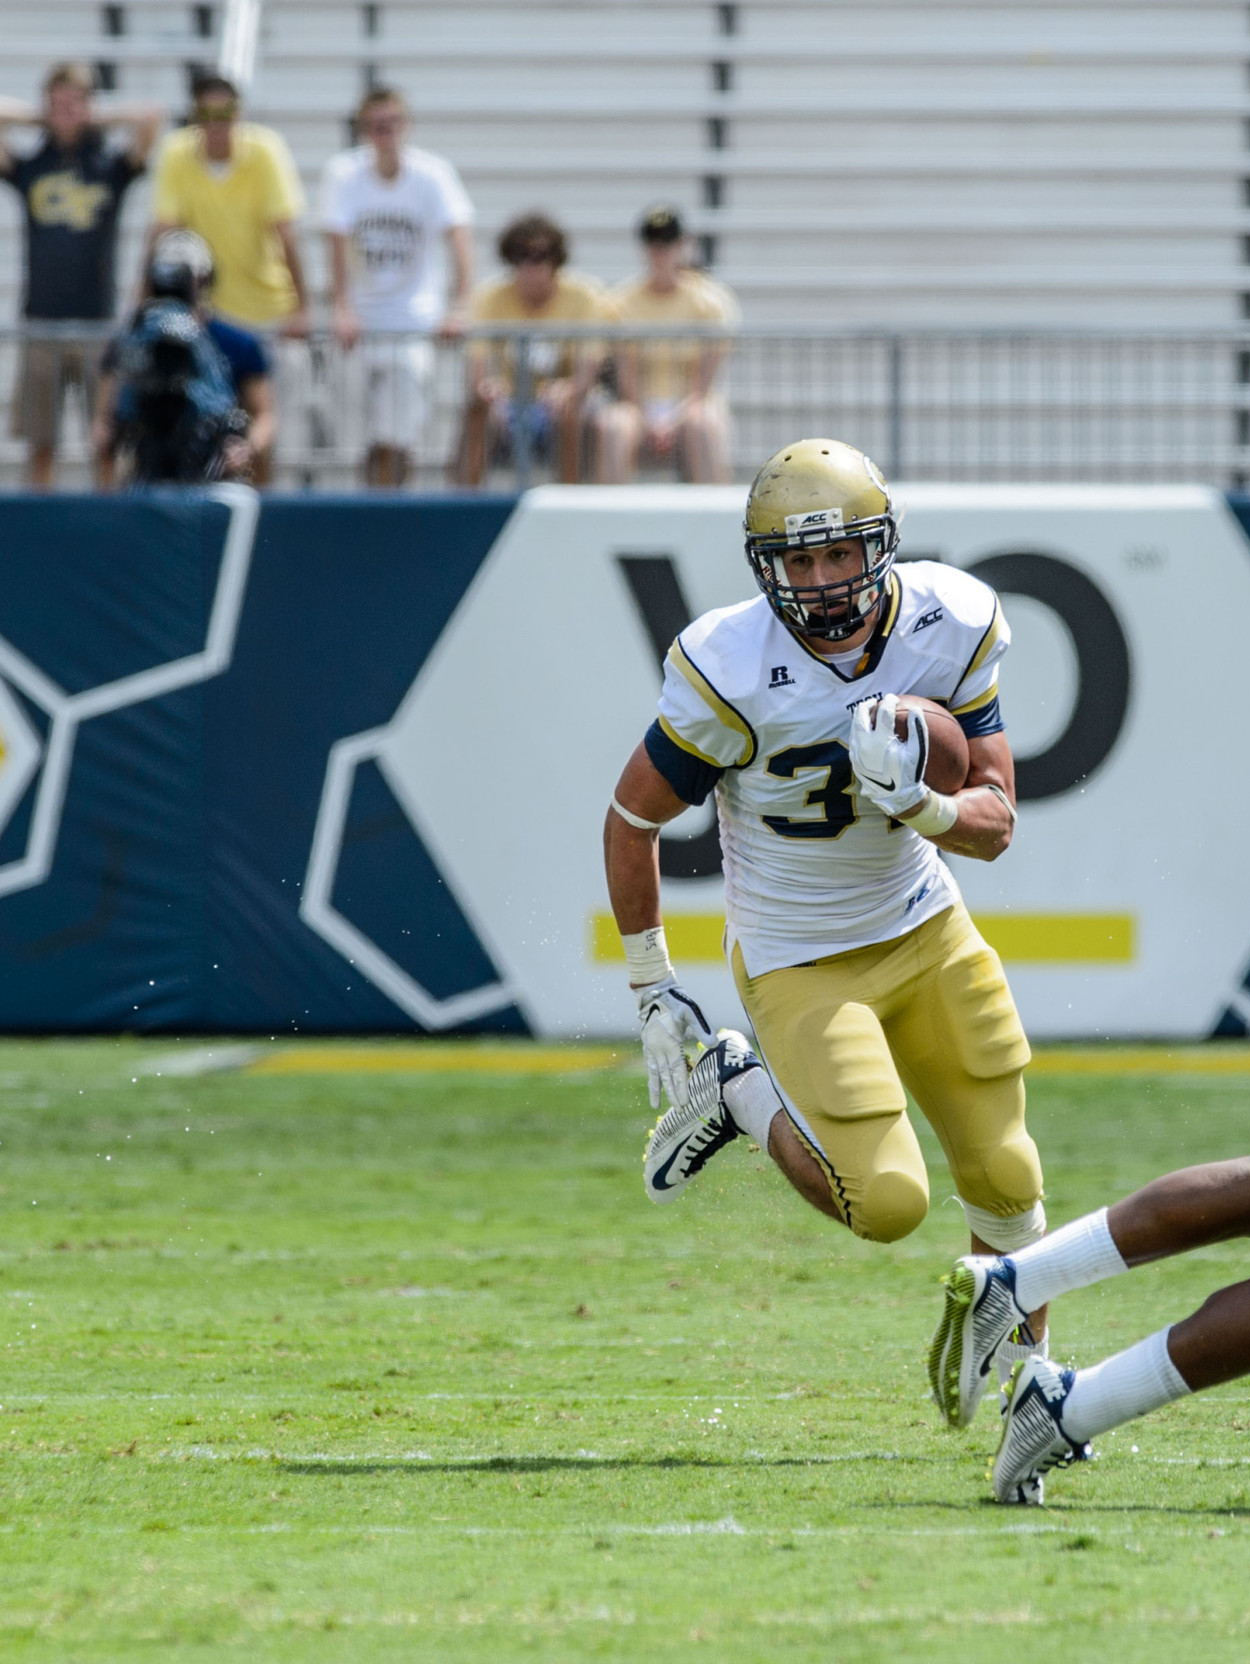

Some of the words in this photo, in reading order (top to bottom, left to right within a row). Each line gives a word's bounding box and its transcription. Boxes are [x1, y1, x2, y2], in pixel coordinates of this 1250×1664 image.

[801, 513, 828, 525] ACC
[913, 606, 943, 631] ACC
[760, 737, 906, 841] 3
